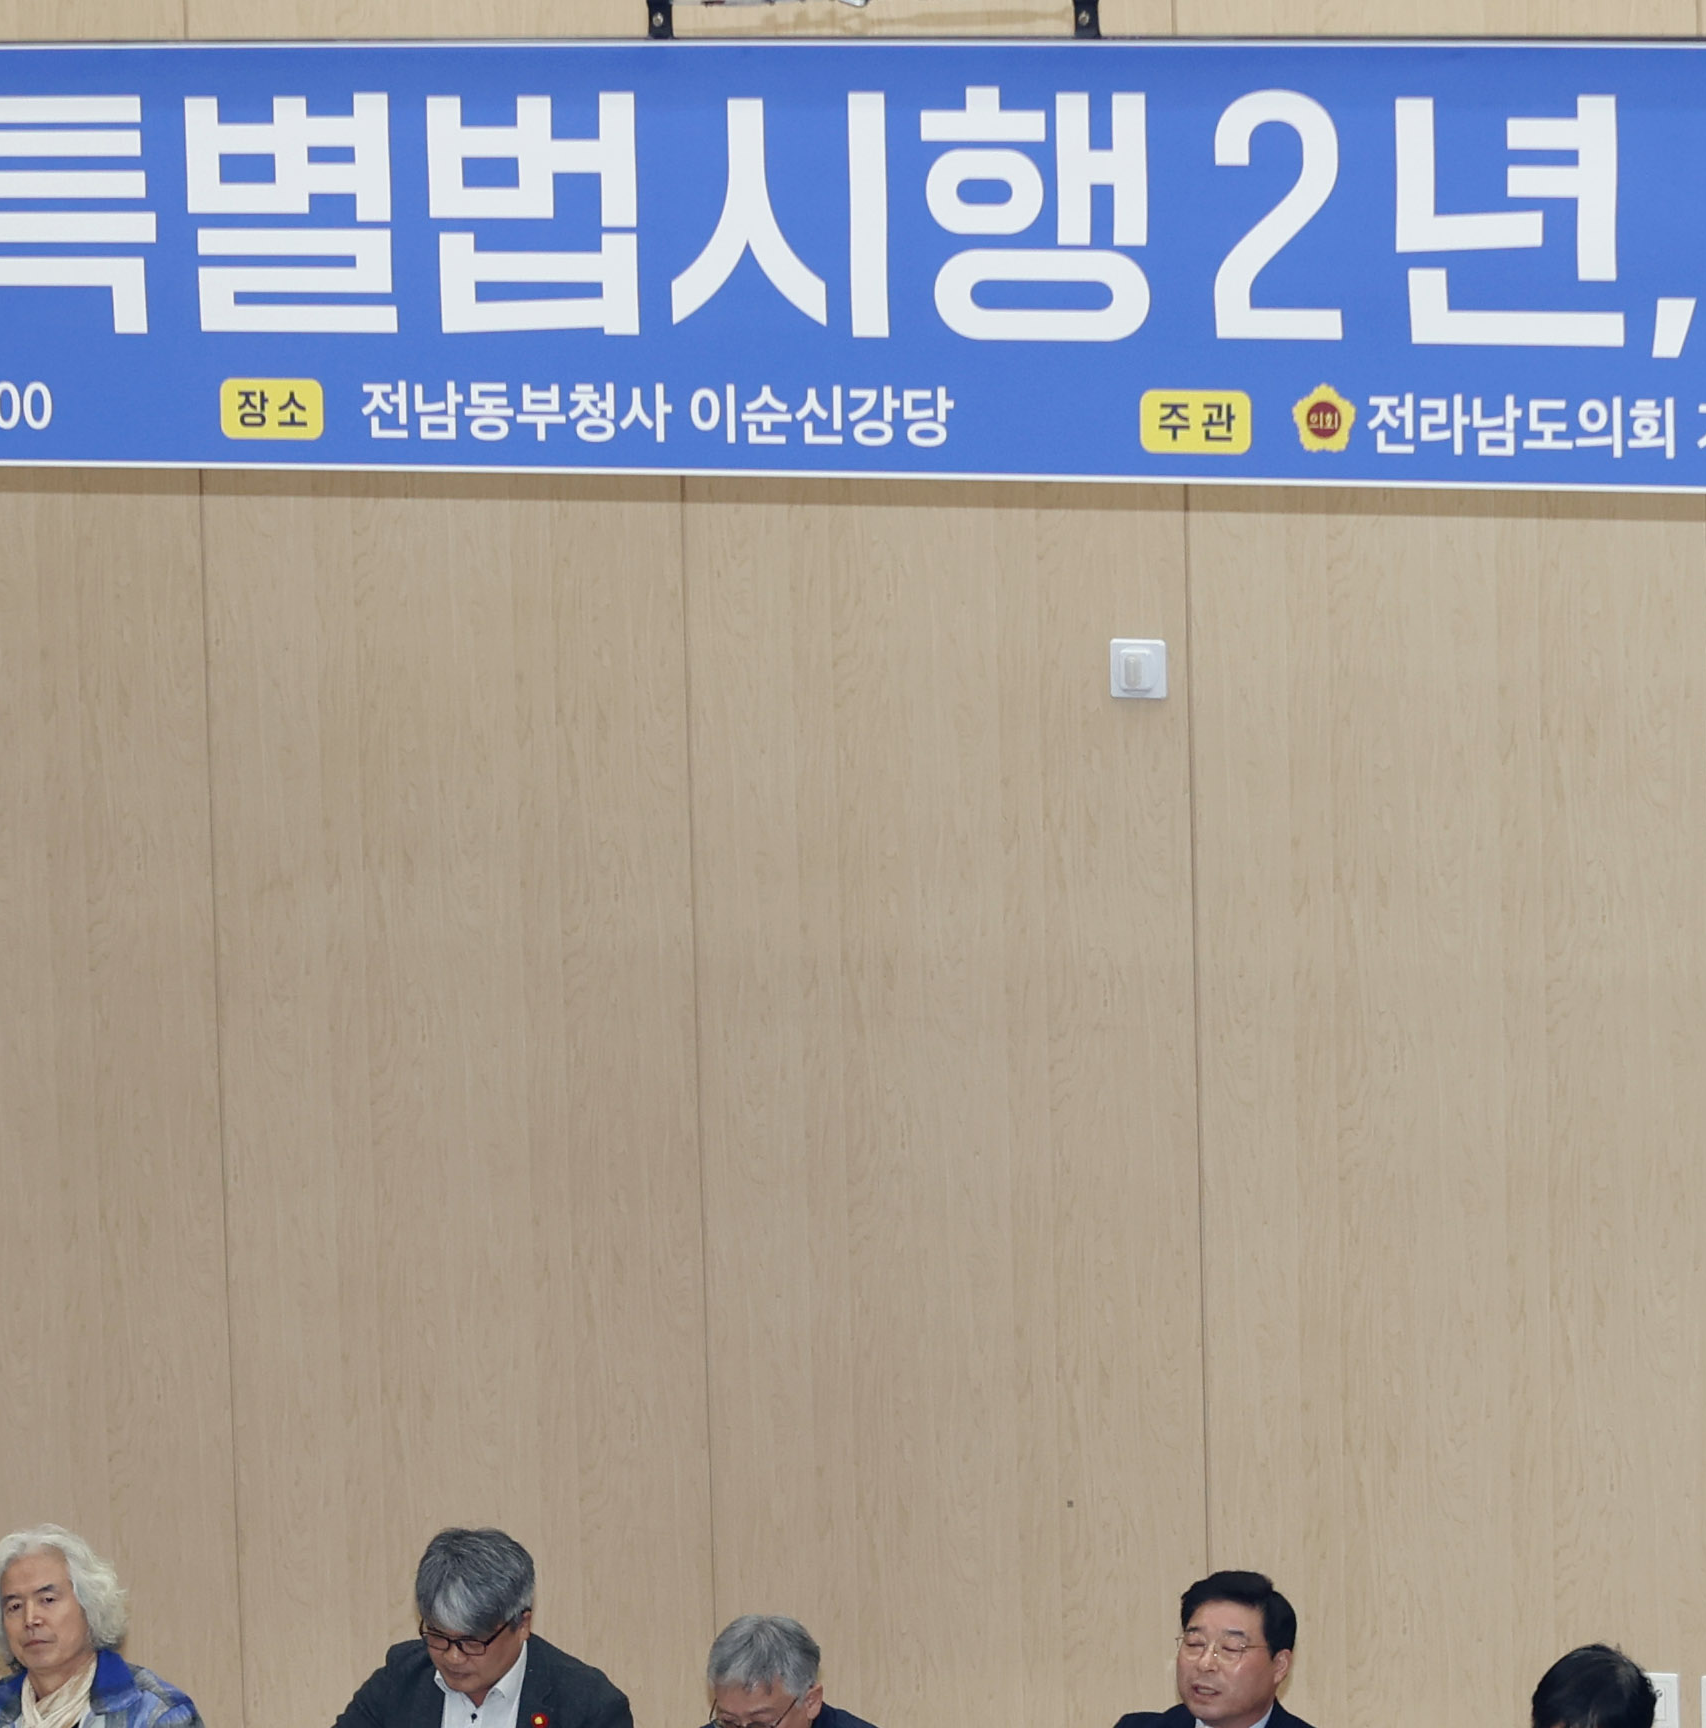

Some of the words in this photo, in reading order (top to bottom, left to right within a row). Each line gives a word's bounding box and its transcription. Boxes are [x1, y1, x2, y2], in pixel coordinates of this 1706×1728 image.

[238, 390, 308, 427] 장소
[361, 379, 673, 443] 전남동부청사
[690, 383, 955, 448] 이순신강당
[1158, 403, 1236, 441] 주관
[1367, 392, 1676, 460] 전라남도의회
